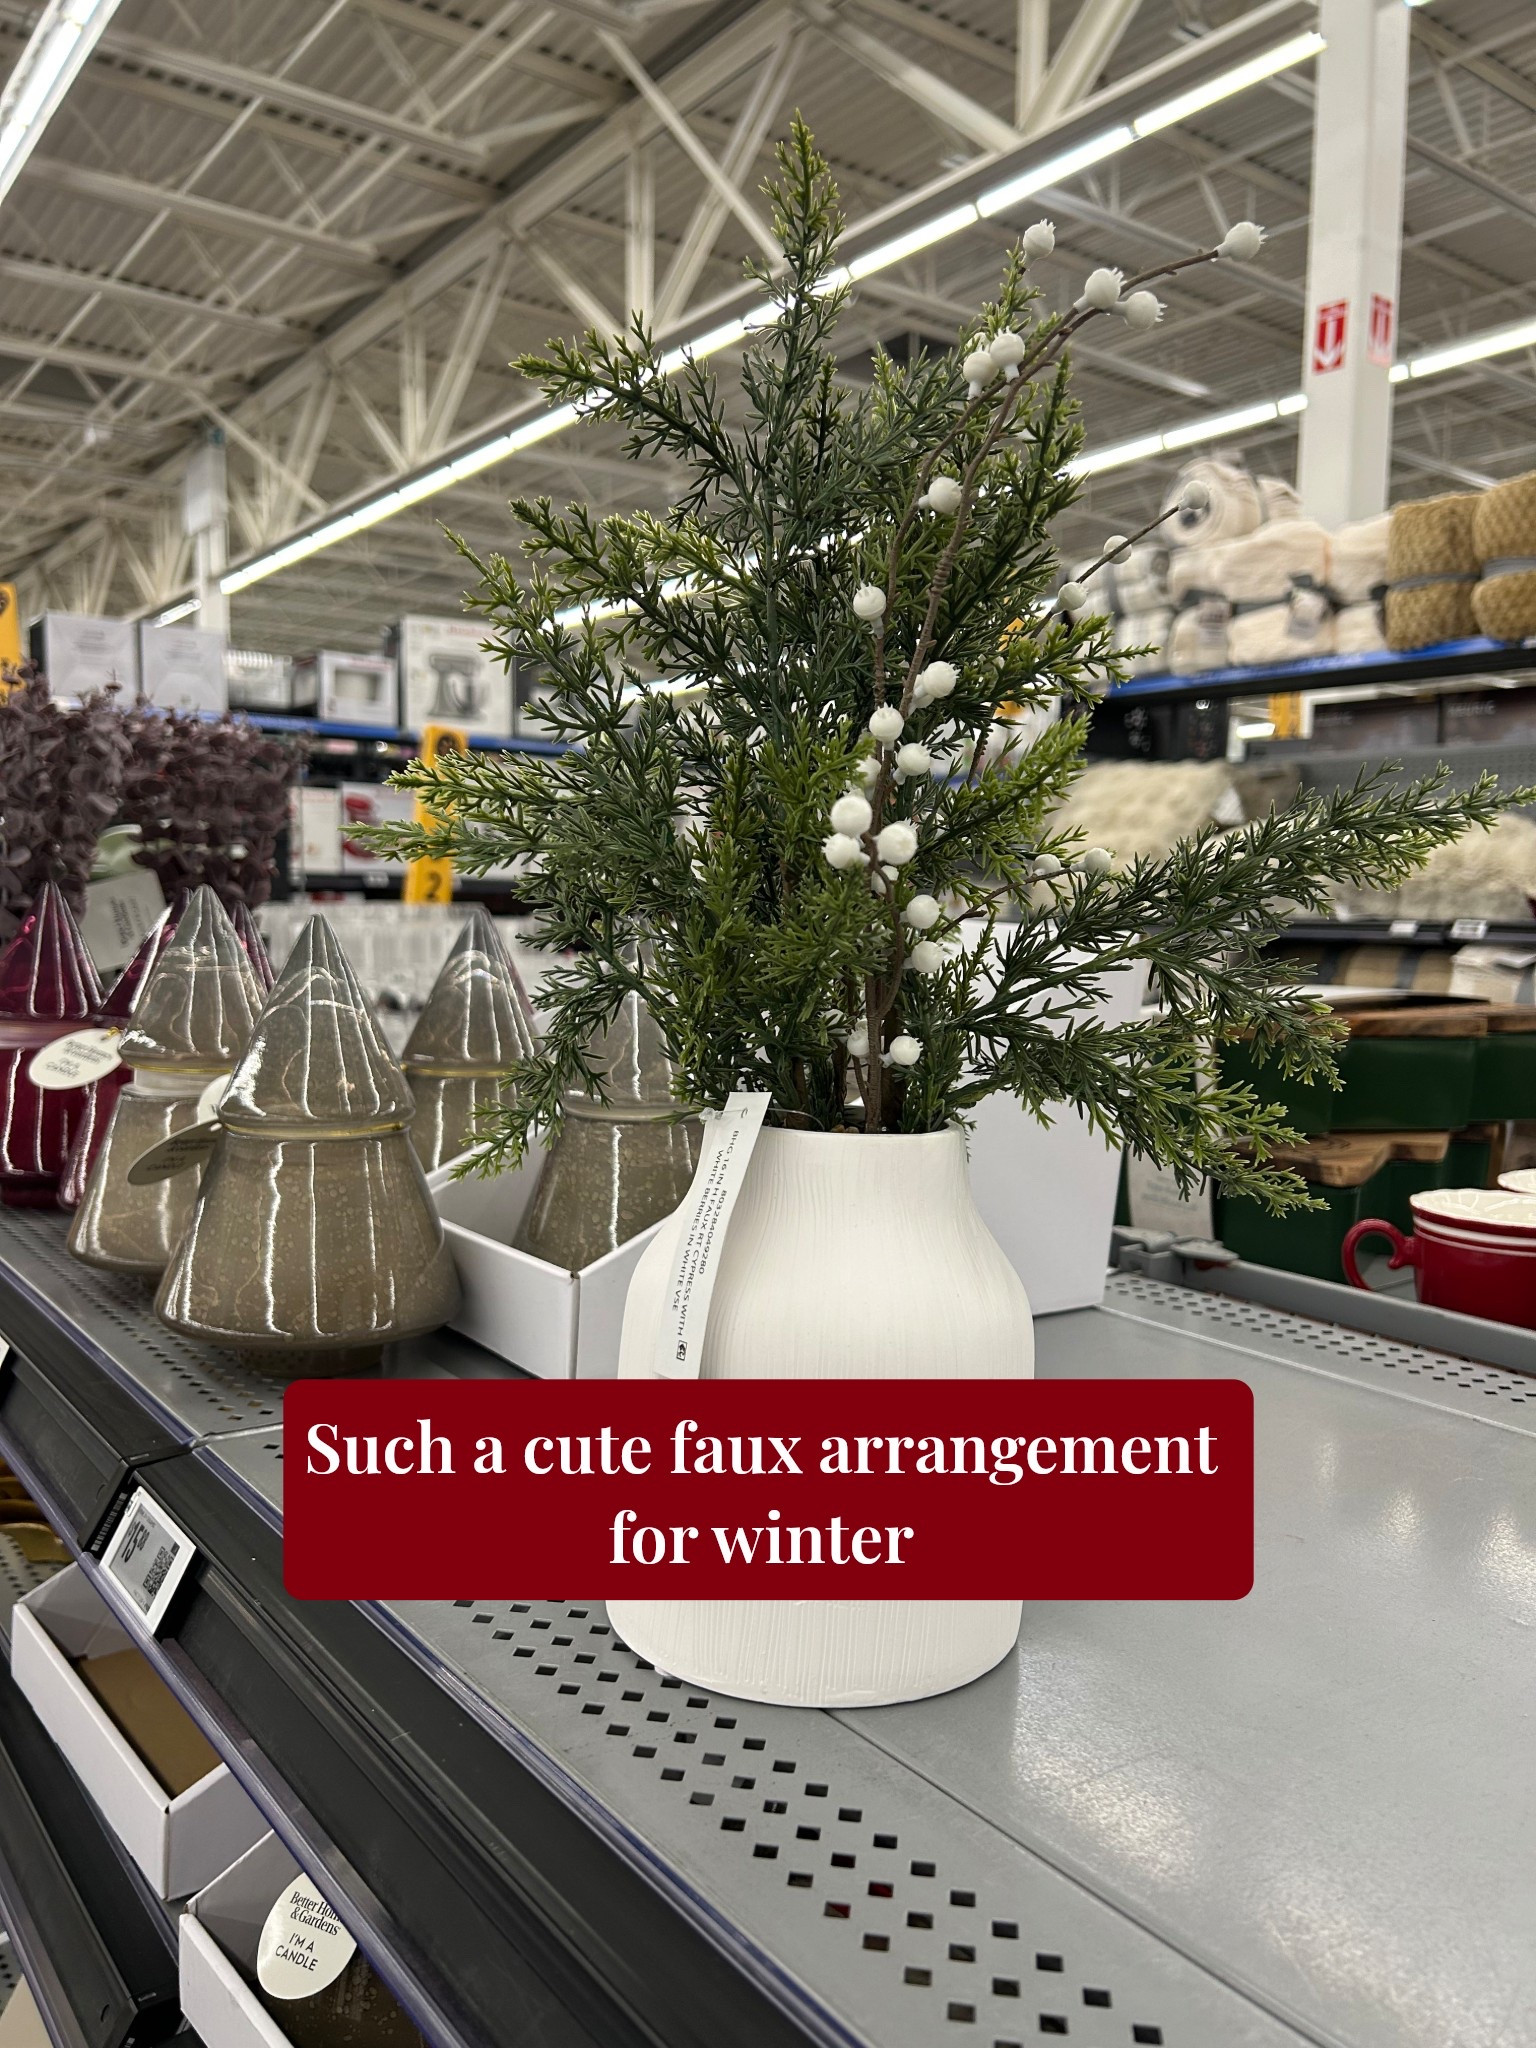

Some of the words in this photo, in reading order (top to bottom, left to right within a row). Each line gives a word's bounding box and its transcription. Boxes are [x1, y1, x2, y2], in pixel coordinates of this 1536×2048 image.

[726, 1130, 740, 1154] BHG
[707, 1149, 724, 1185] WHITE
[716, 1173, 725, 1185] IN
[712, 1187, 719, 1196] H
[691, 1187, 710, 1231] BERRIES
[700, 1199, 715, 1230] FAUX
[687, 1234, 695, 1247] IN
[695, 1232, 705, 1247] RT
[699, 1190, 727, 1275] 803284049280
[677, 1249, 691, 1287] WHITE
[683, 1249, 700, 1302] CYPRESS
[672, 1289, 681, 1311] VSE
[677, 1304, 688, 1336] WITH
[290, 1891, 319, 1912] Better
[317, 1901, 340, 1922] Hom
[289, 1932, 306, 1949] I'M
[305, 1940, 315, 1953] A
[275, 1944, 319, 1972] CANDLE
